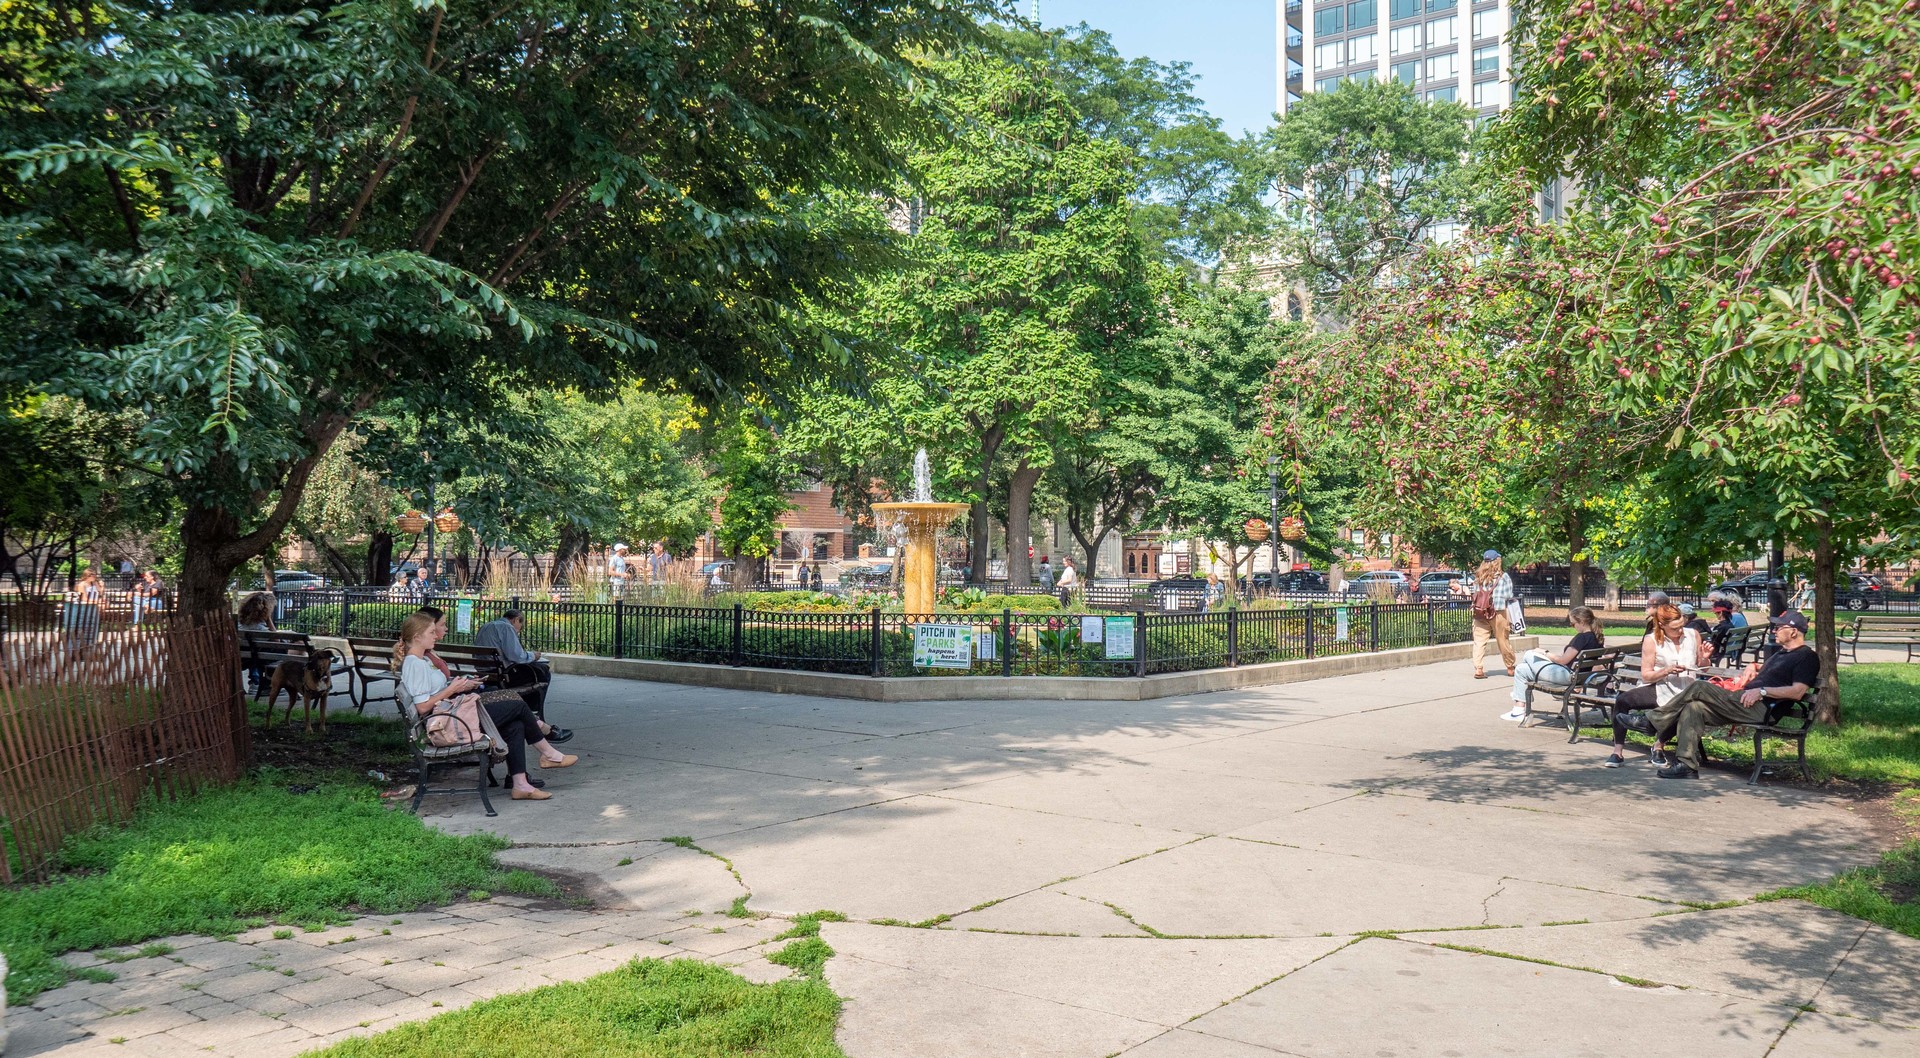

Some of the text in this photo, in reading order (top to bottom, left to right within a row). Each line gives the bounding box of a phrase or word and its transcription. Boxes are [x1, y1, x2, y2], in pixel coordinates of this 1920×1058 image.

[920, 627, 956, 638] PITCH IN
[926, 638, 955, 648] PARKS
